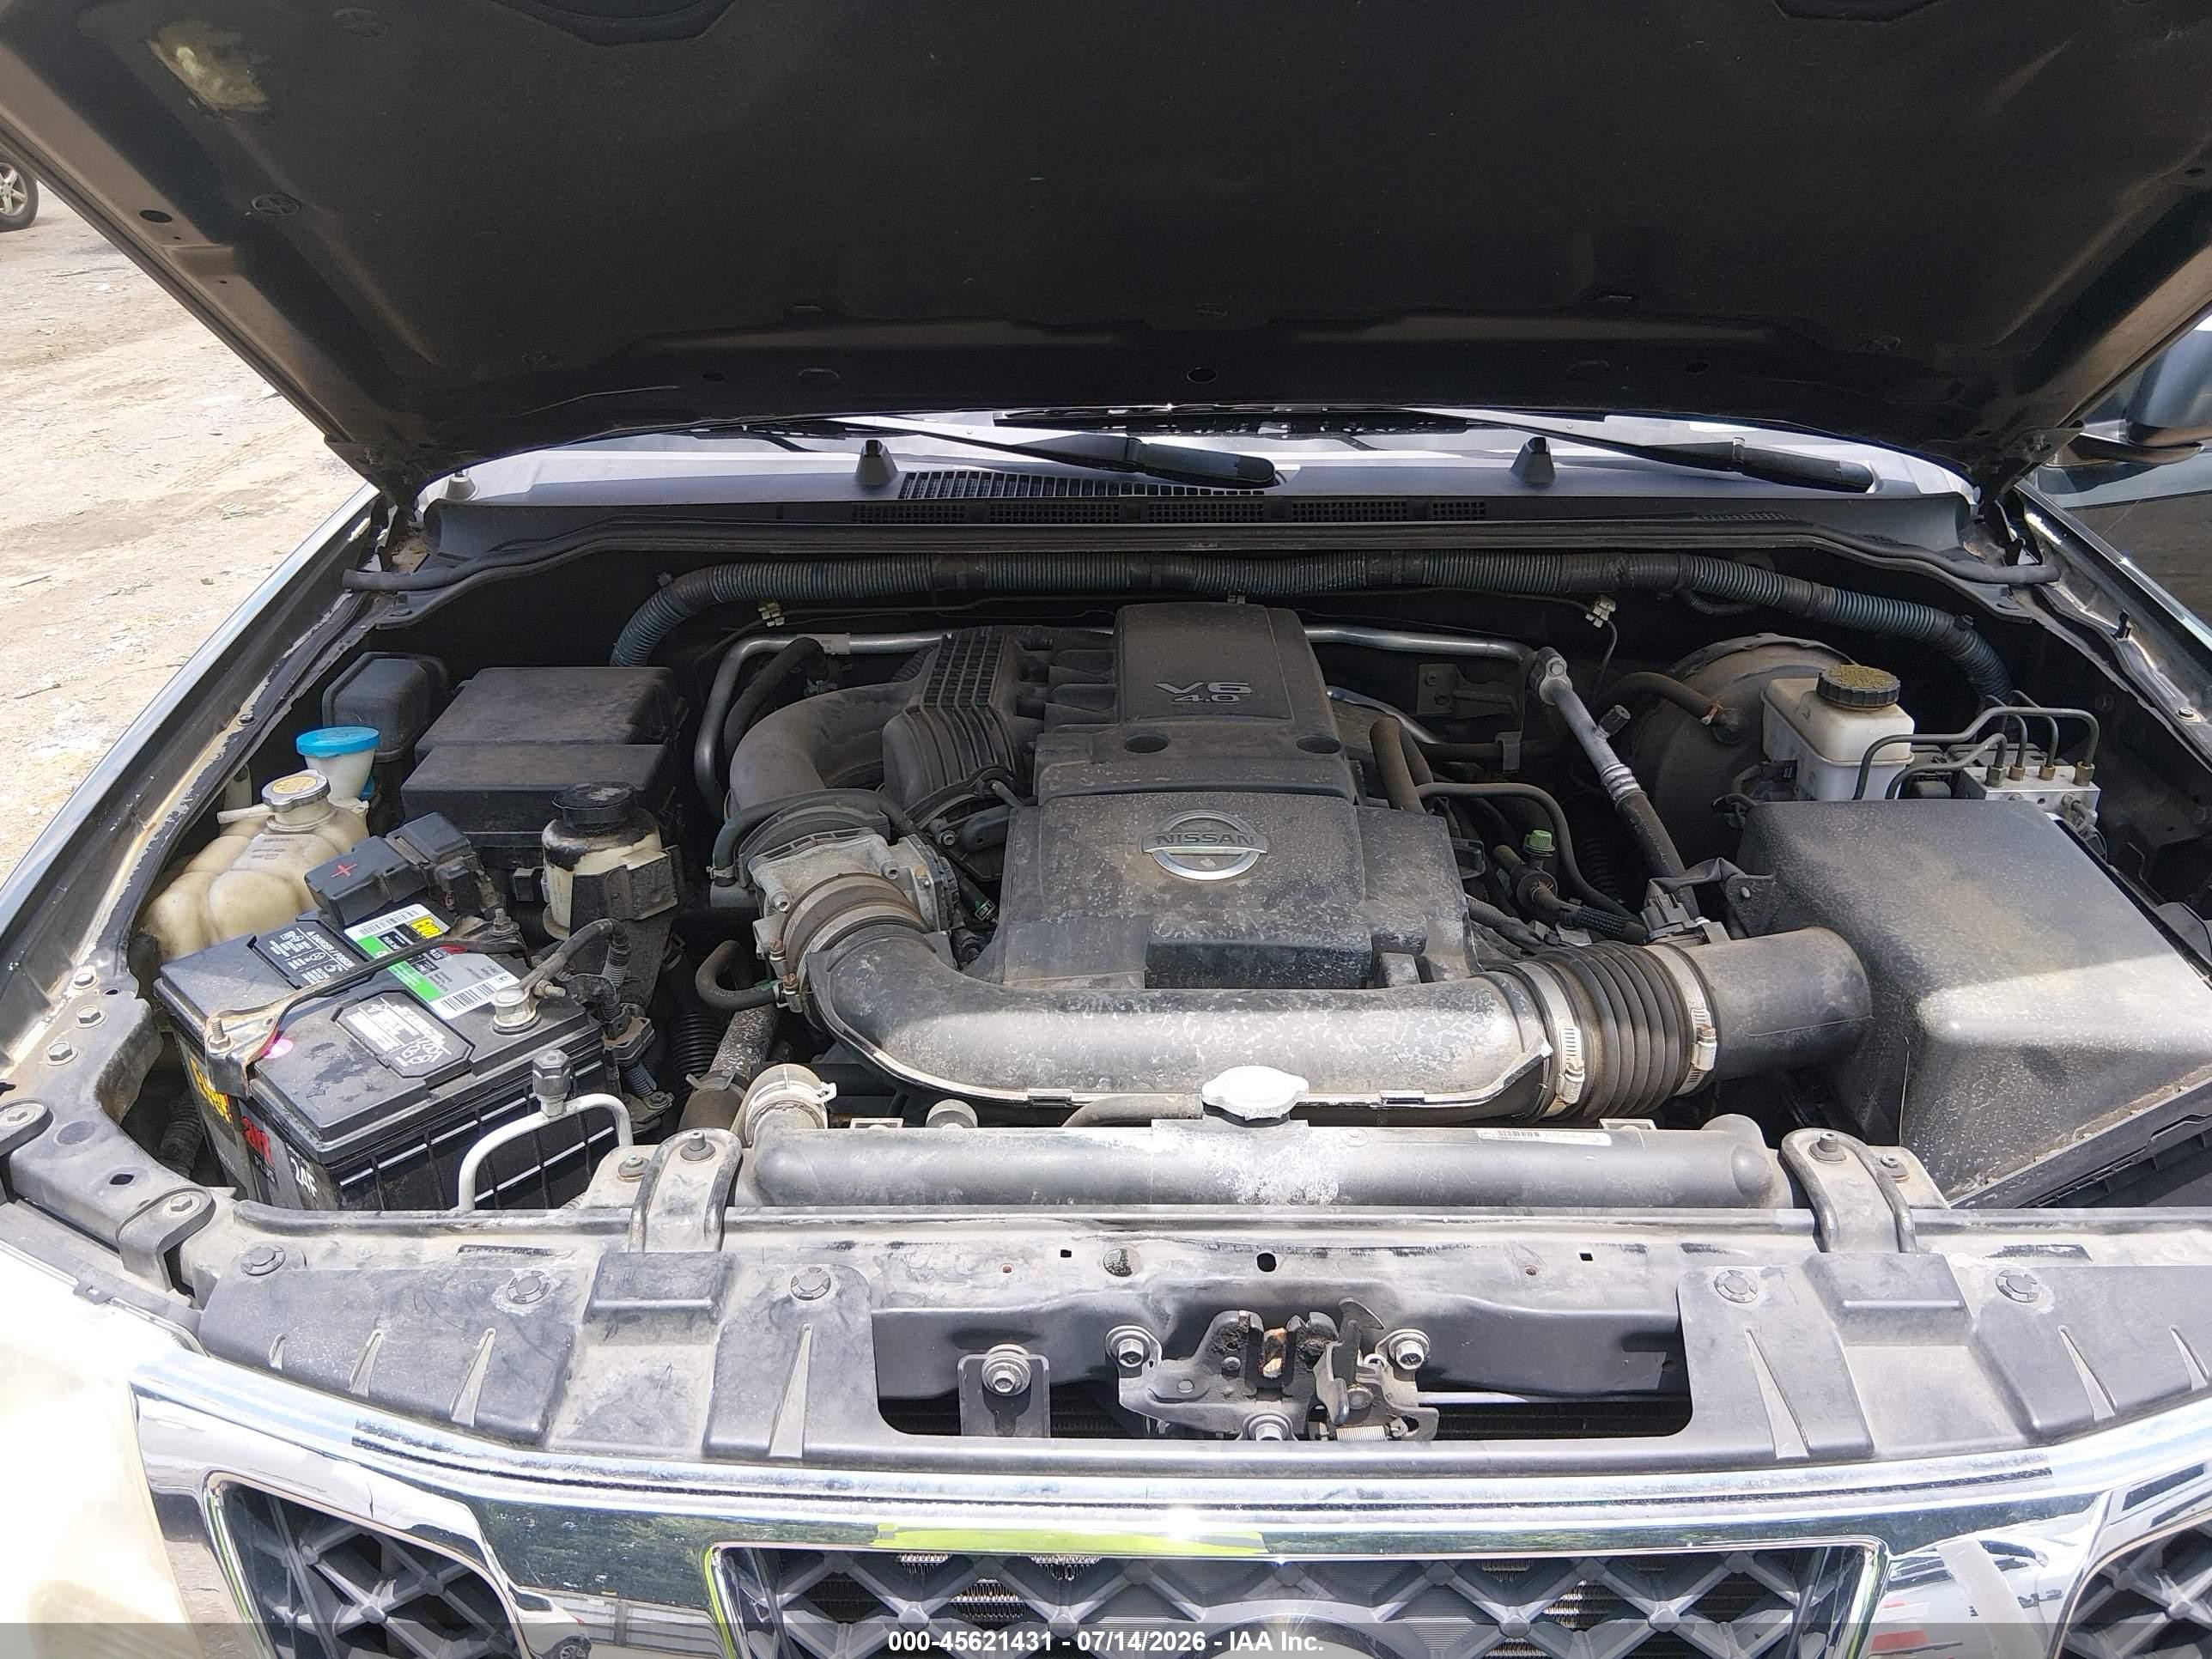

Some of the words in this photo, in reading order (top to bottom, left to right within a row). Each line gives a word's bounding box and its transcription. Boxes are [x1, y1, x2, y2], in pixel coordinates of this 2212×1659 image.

[1154, 681, 1254, 696] V6
[1173, 694, 1243, 705] 4.0
[1156, 830, 1255, 846] NISSAN
[289, 1157, 318, 1198] 24F
